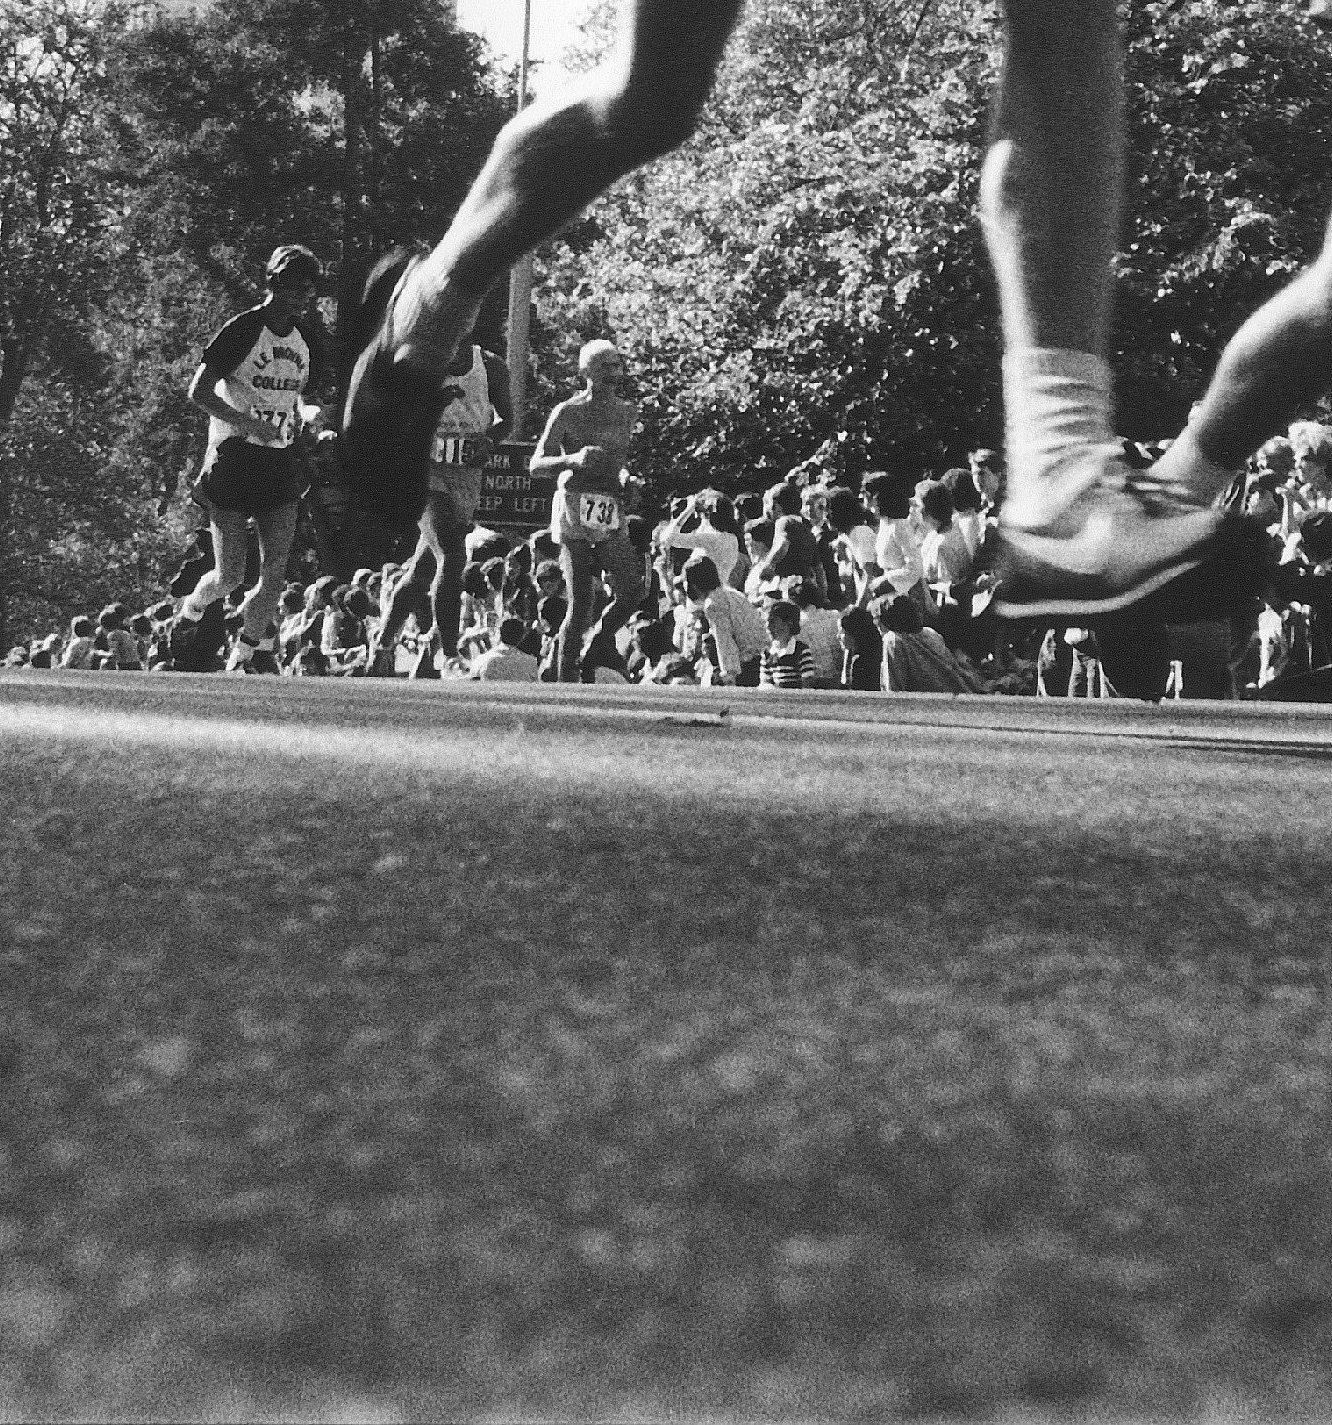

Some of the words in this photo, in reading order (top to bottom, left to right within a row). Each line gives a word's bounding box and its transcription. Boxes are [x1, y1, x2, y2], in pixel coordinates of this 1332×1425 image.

[483, 454, 511, 469] ARK
[485, 475, 532, 491] NORTH
[513, 497, 547, 512] LEFT
